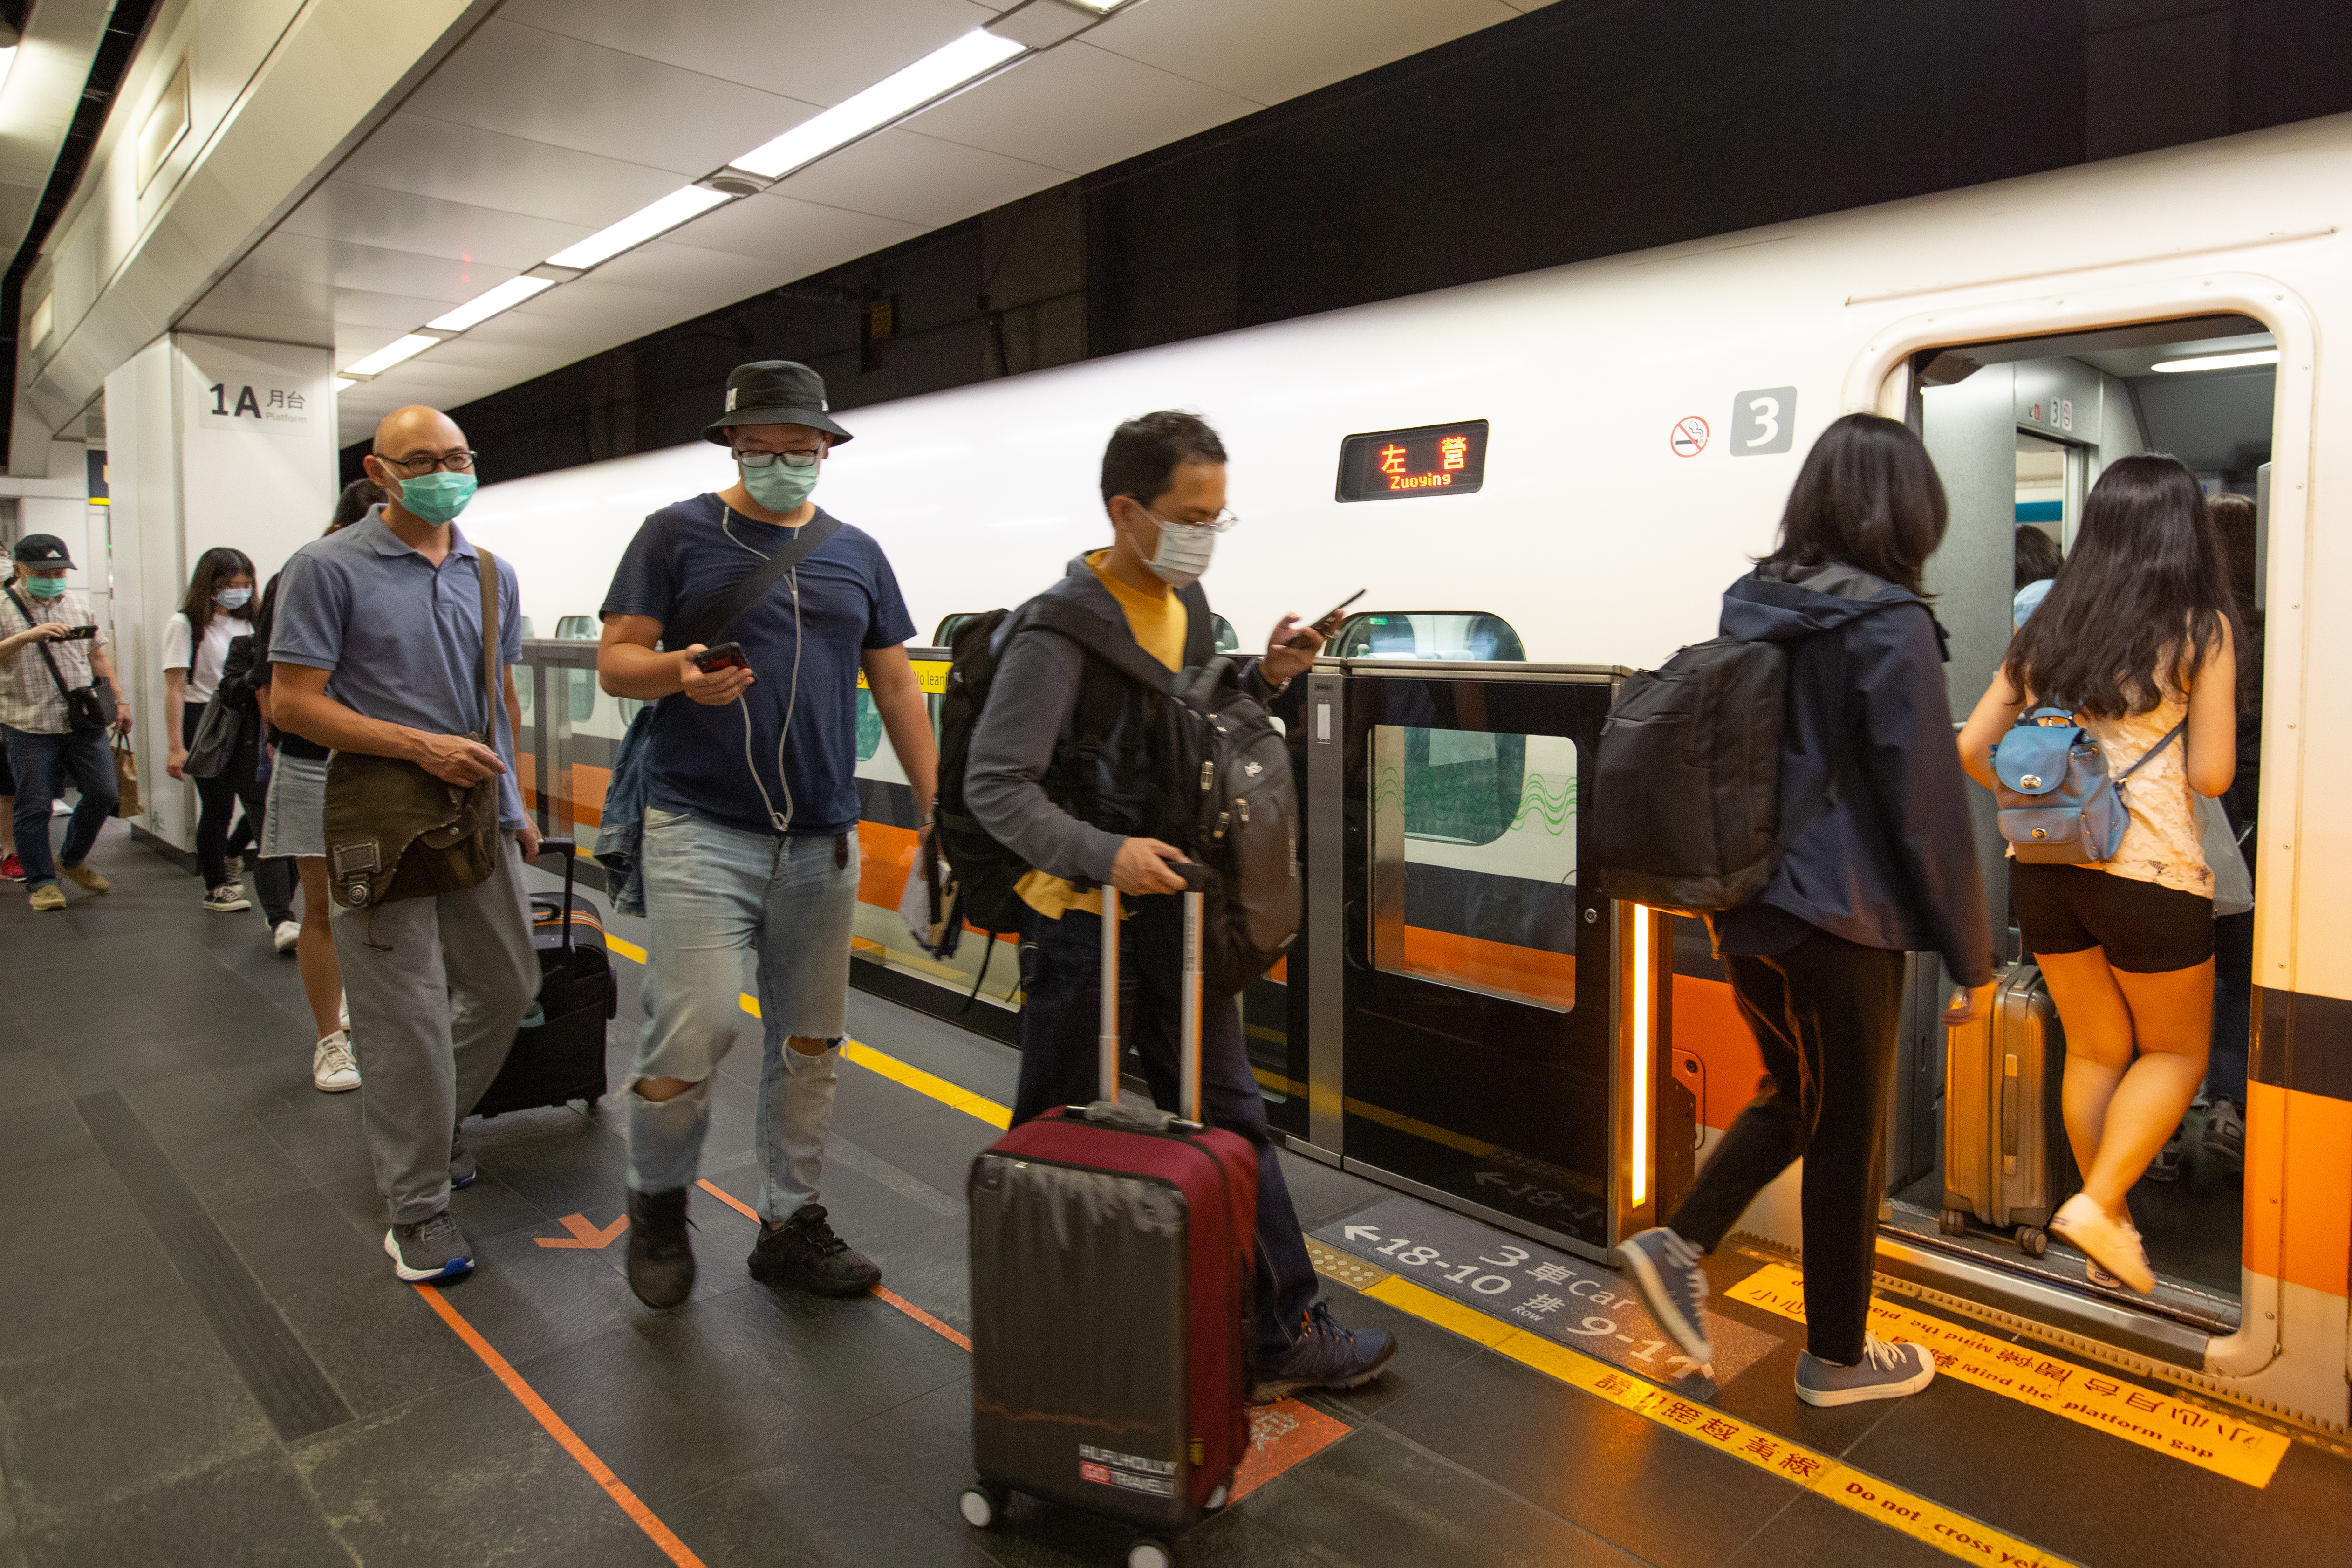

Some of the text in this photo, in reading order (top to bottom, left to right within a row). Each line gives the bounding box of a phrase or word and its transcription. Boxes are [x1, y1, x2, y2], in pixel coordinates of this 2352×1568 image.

[209, 383, 305, 419] 1A 月台
[266, 412, 307, 423] Platform
[1746, 396, 1780, 447] 3
[1390, 472, 1451, 490] Zuoying
[1375, 1237, 1512, 1295] 18-10
[1522, 1294, 1566, 1313] 排
[1479, 1244, 1638, 1311] 3 車 Car
[1910, 1319, 1940, 1335] the
[1945, 1331, 1993, 1353] Mind
[1962, 1363, 2013, 1387] Mind
[2018, 1383, 2052, 1401] the
[2061, 1400, 2163, 1441] platform
[2169, 1437, 2214, 1458] gap
[1845, 1482, 1876, 1501] Do
[1880, 1499, 1921, 1522] not
[1933, 1522, 1994, 1555] cross
